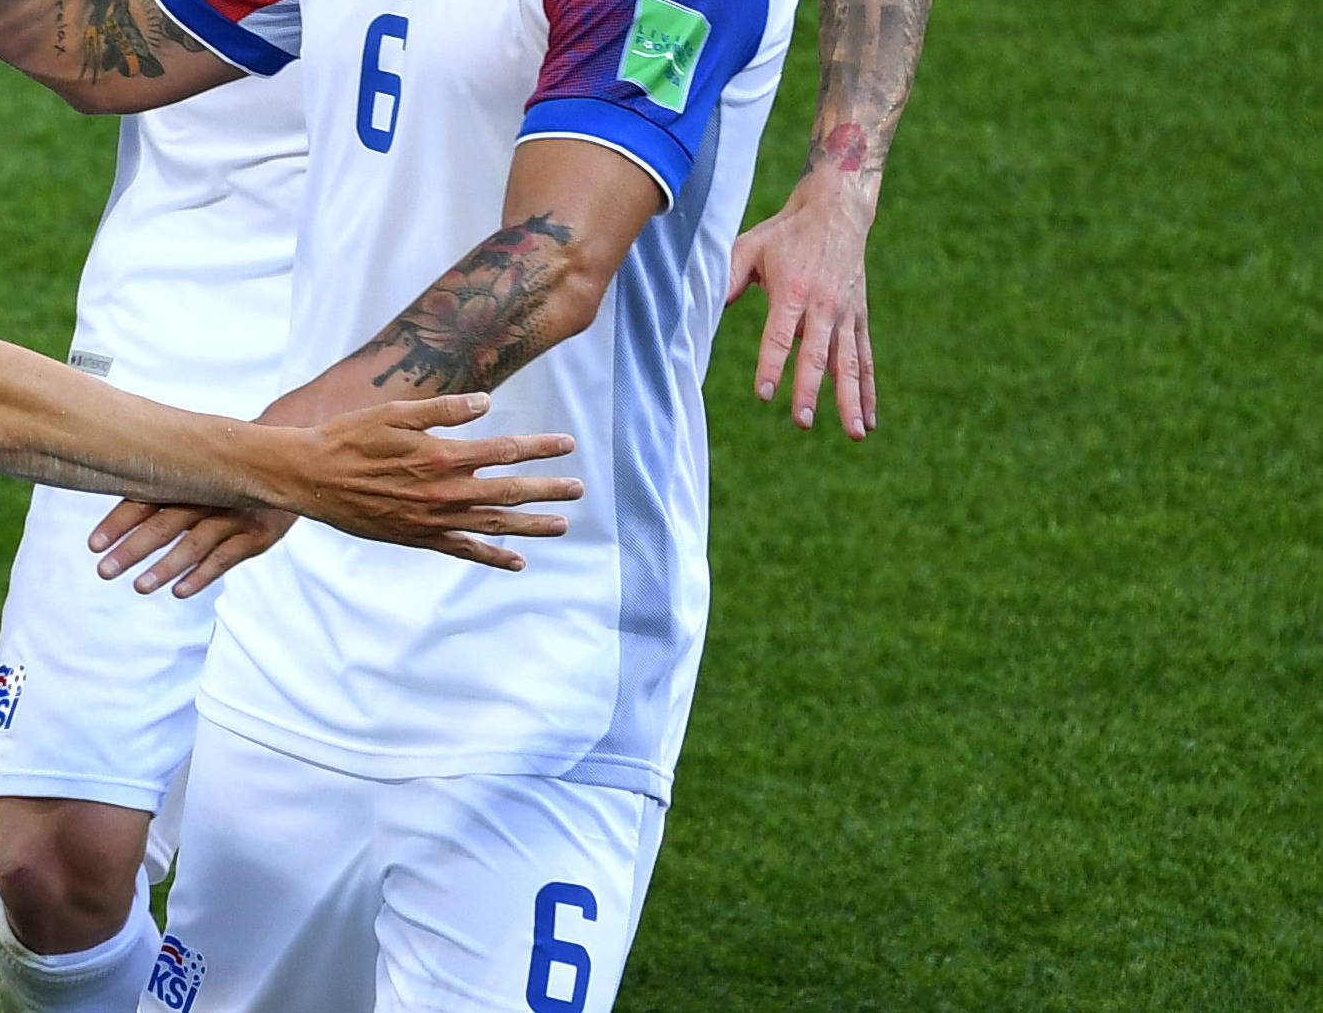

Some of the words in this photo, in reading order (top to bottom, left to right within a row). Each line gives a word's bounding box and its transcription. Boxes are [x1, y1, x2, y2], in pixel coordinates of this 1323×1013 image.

[356, 13, 409, 154] 6
[147, 962, 197, 1013] KSI
[525, 881, 597, 1013] 6
